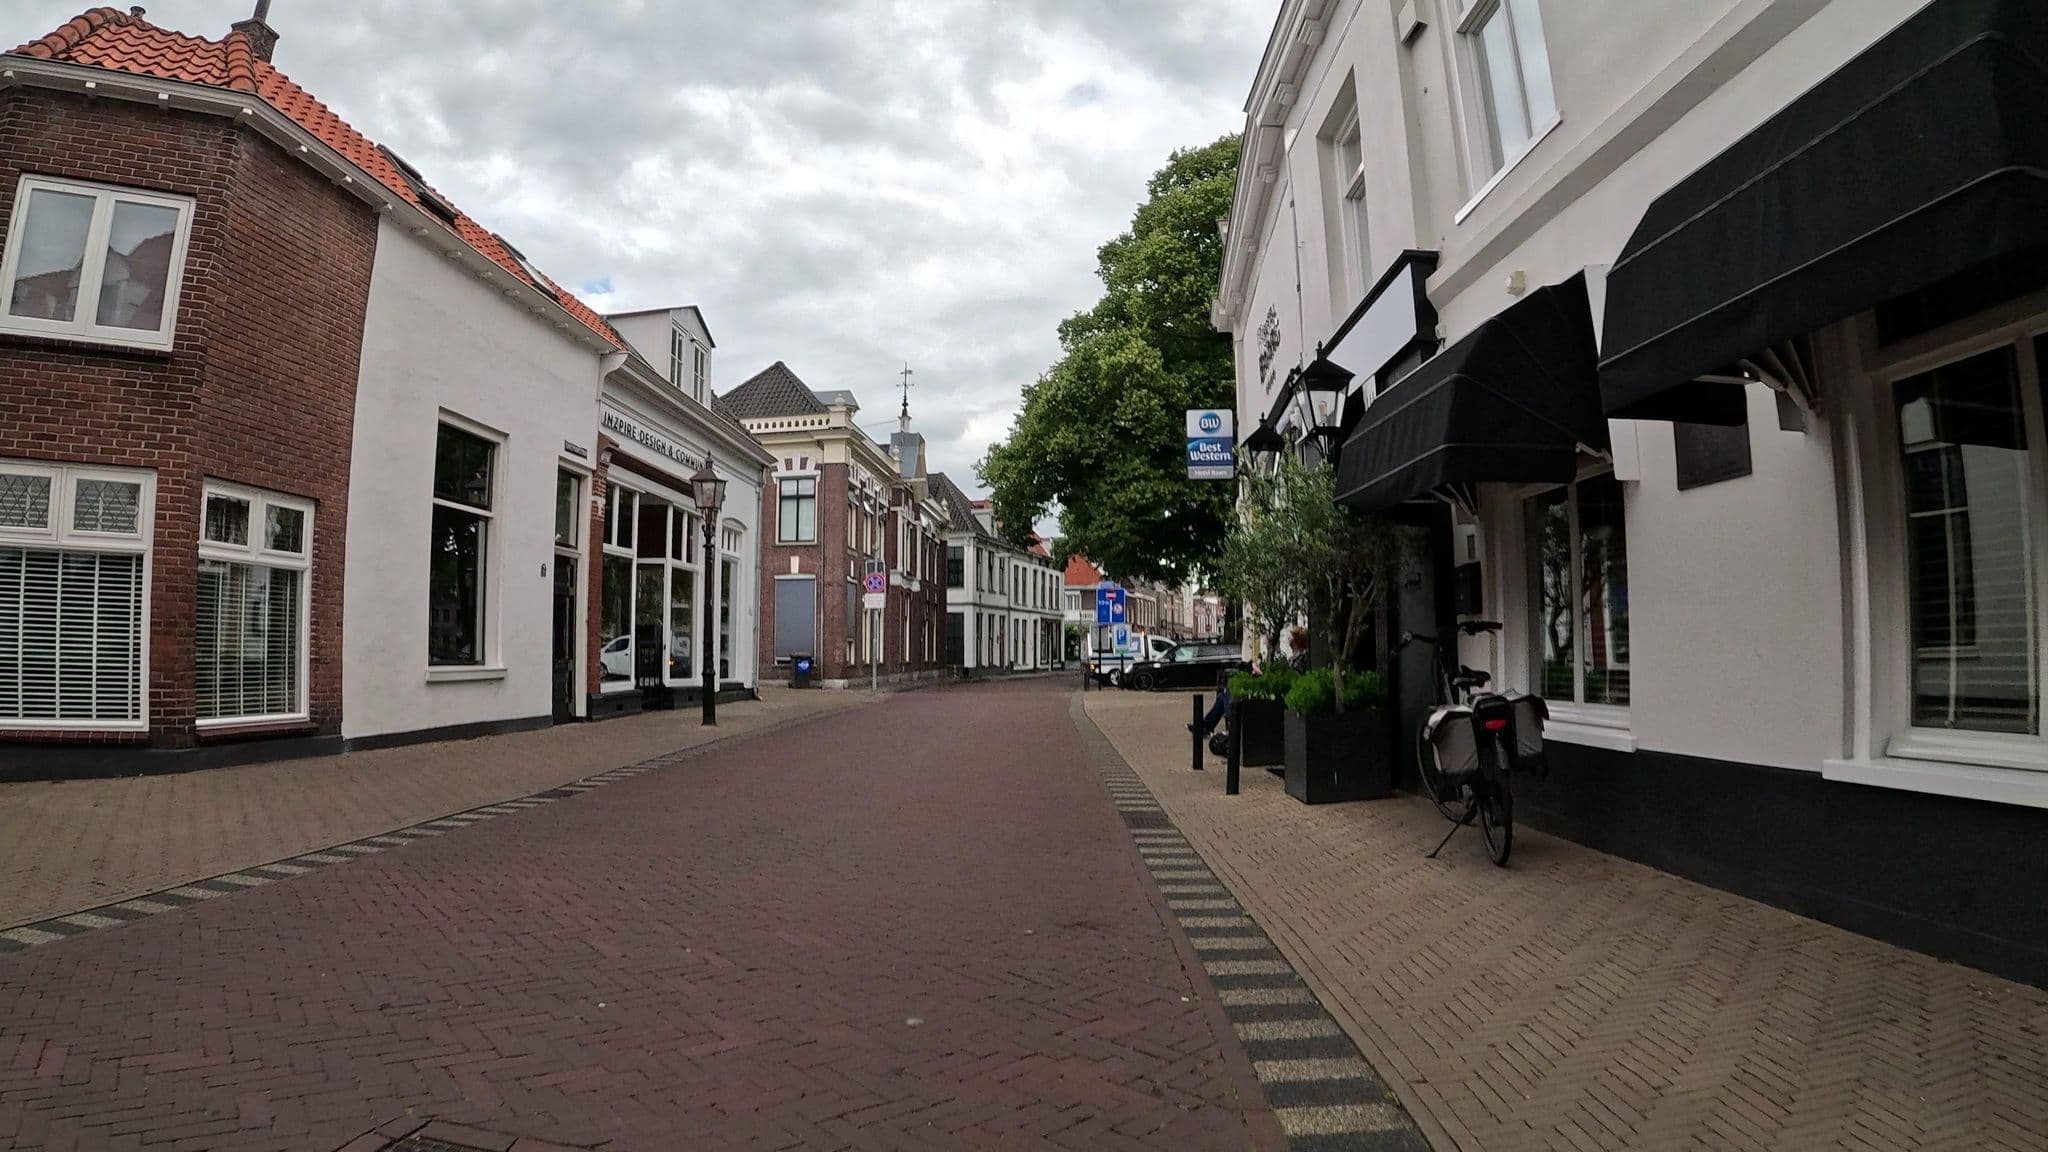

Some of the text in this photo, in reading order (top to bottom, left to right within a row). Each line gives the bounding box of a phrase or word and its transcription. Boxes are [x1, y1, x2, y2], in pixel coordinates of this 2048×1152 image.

[1201, 418, 1219, 429] BW
[603, 411, 637, 439] INZPIRE
[639, 430, 667, 454] DESIGN
[1199, 442, 1222, 452] Best
[1189, 451, 1231, 461] Western
